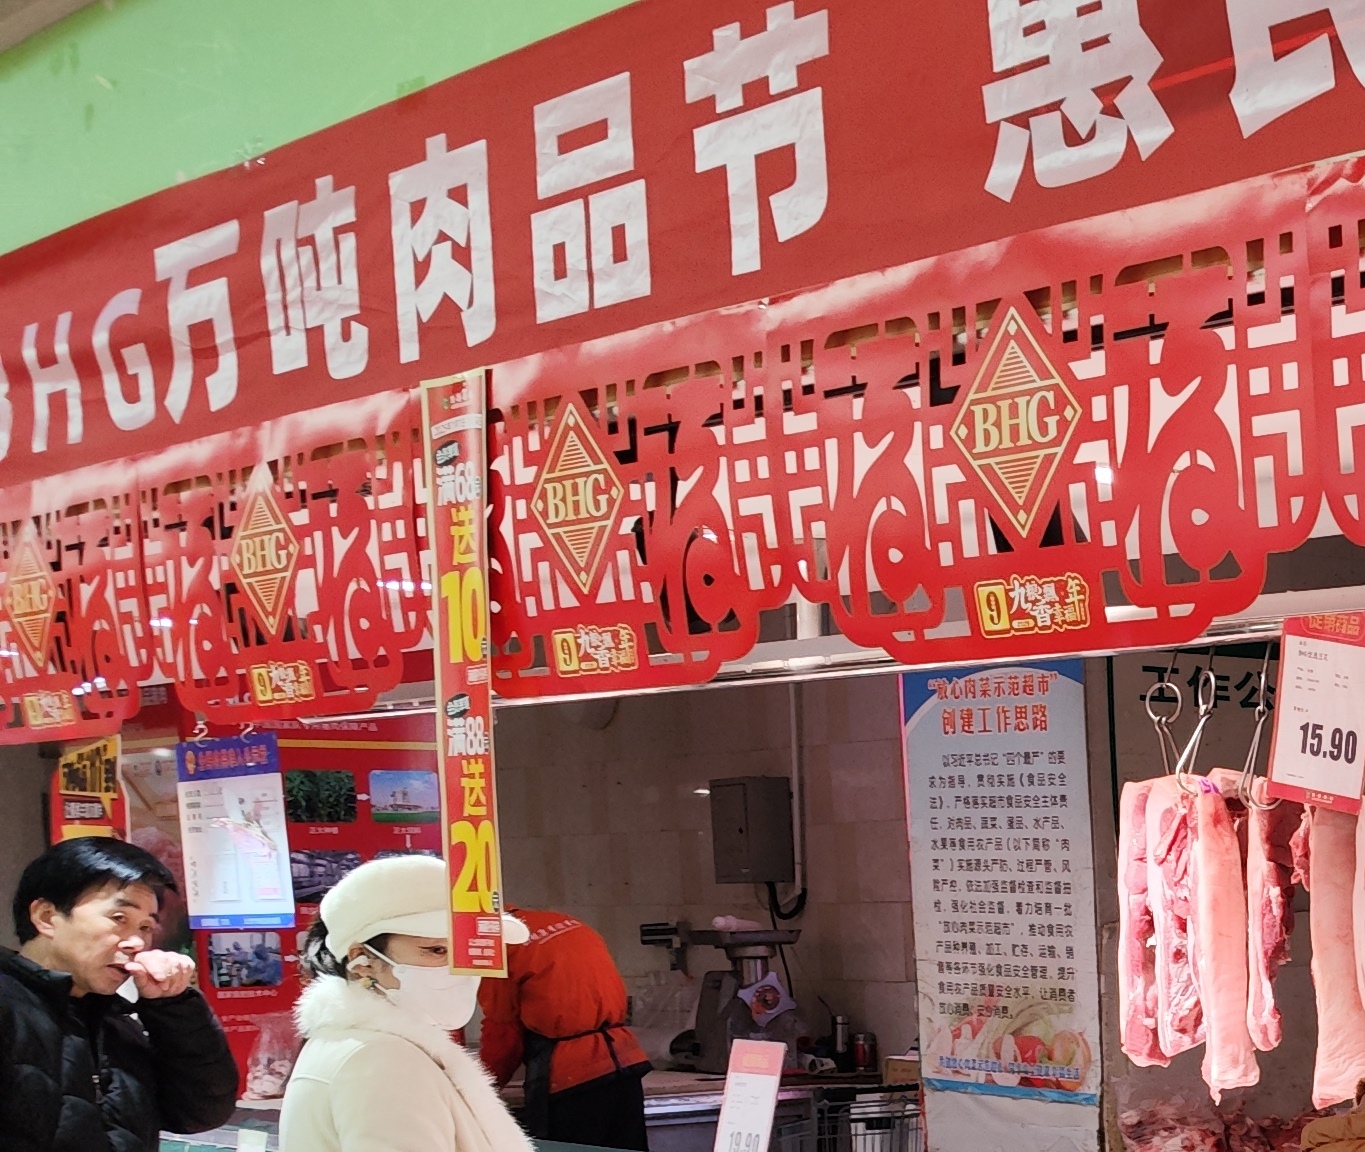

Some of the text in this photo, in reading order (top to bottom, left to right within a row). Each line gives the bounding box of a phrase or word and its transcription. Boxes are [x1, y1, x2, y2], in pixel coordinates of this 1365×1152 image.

[970, 388, 1061, 455] BHG
[544, 472, 610, 523] BHG
[240, 531, 289, 576] BHG
[450, 504, 477, 566] 送
[441, 566, 487, 664] 10
[941, 703, 1049, 736] 创建工作思路
[1299, 721, 1358, 765] 15.90
[461, 758, 487, 817] 送
[450, 819, 498, 913] 20
